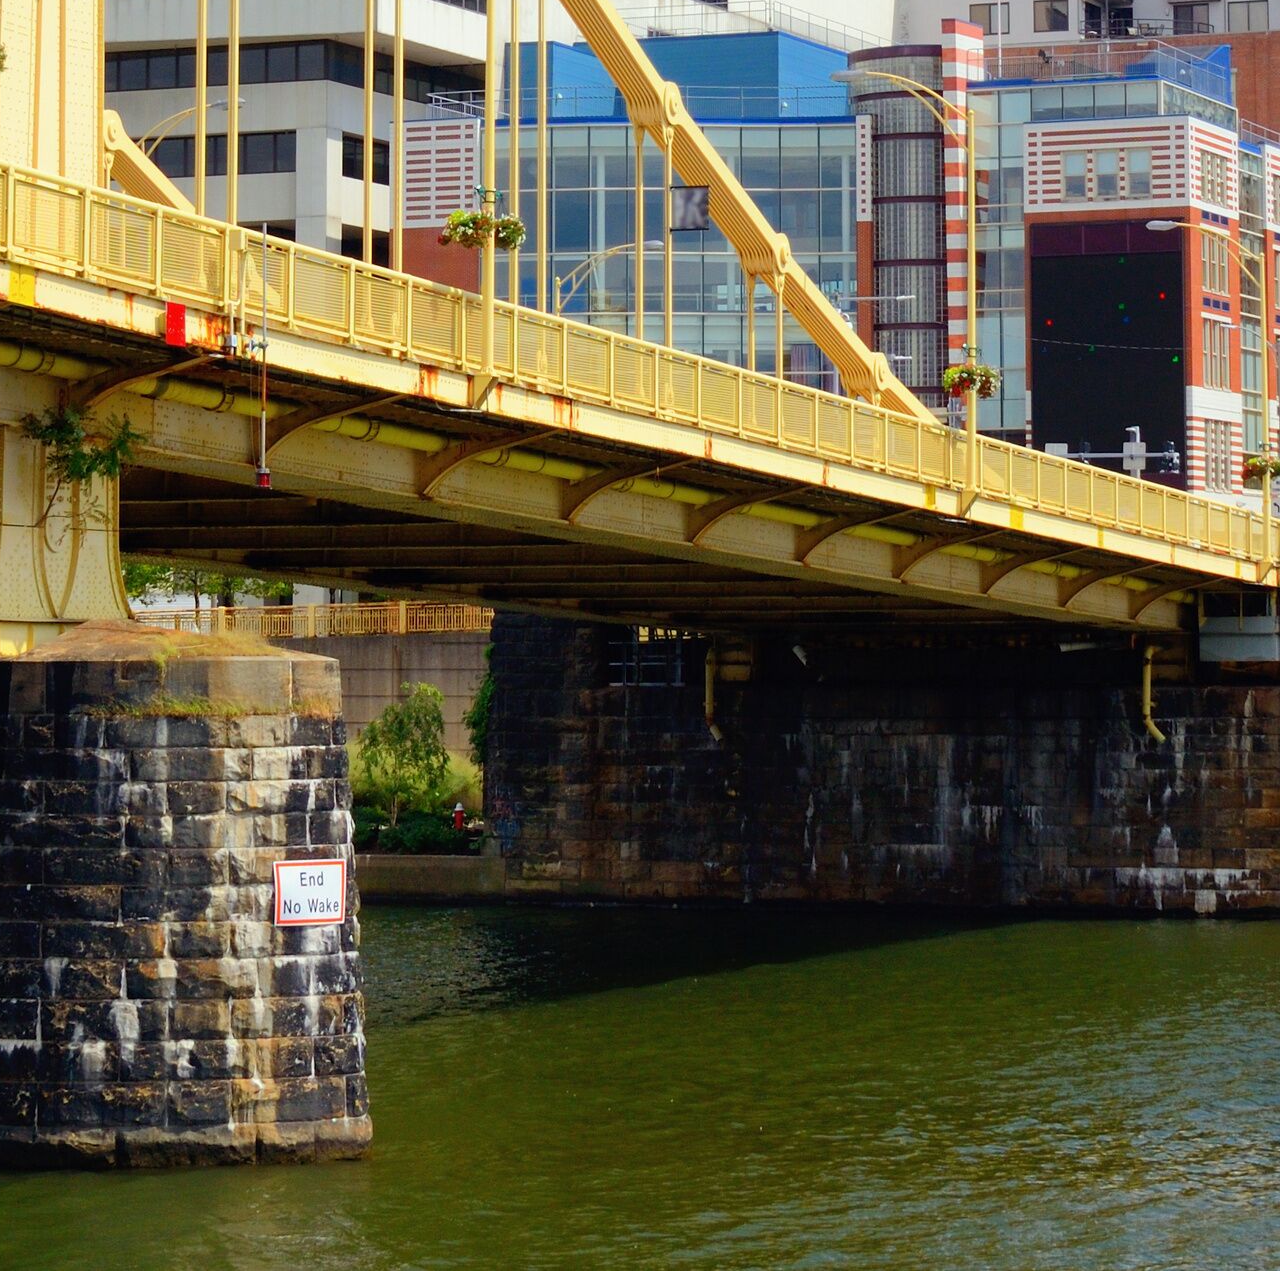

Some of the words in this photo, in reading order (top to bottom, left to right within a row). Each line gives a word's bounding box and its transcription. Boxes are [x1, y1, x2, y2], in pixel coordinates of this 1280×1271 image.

[300, 872, 324, 886] End
[283, 899, 301, 914] No
[307, 898, 340, 913] Wake
